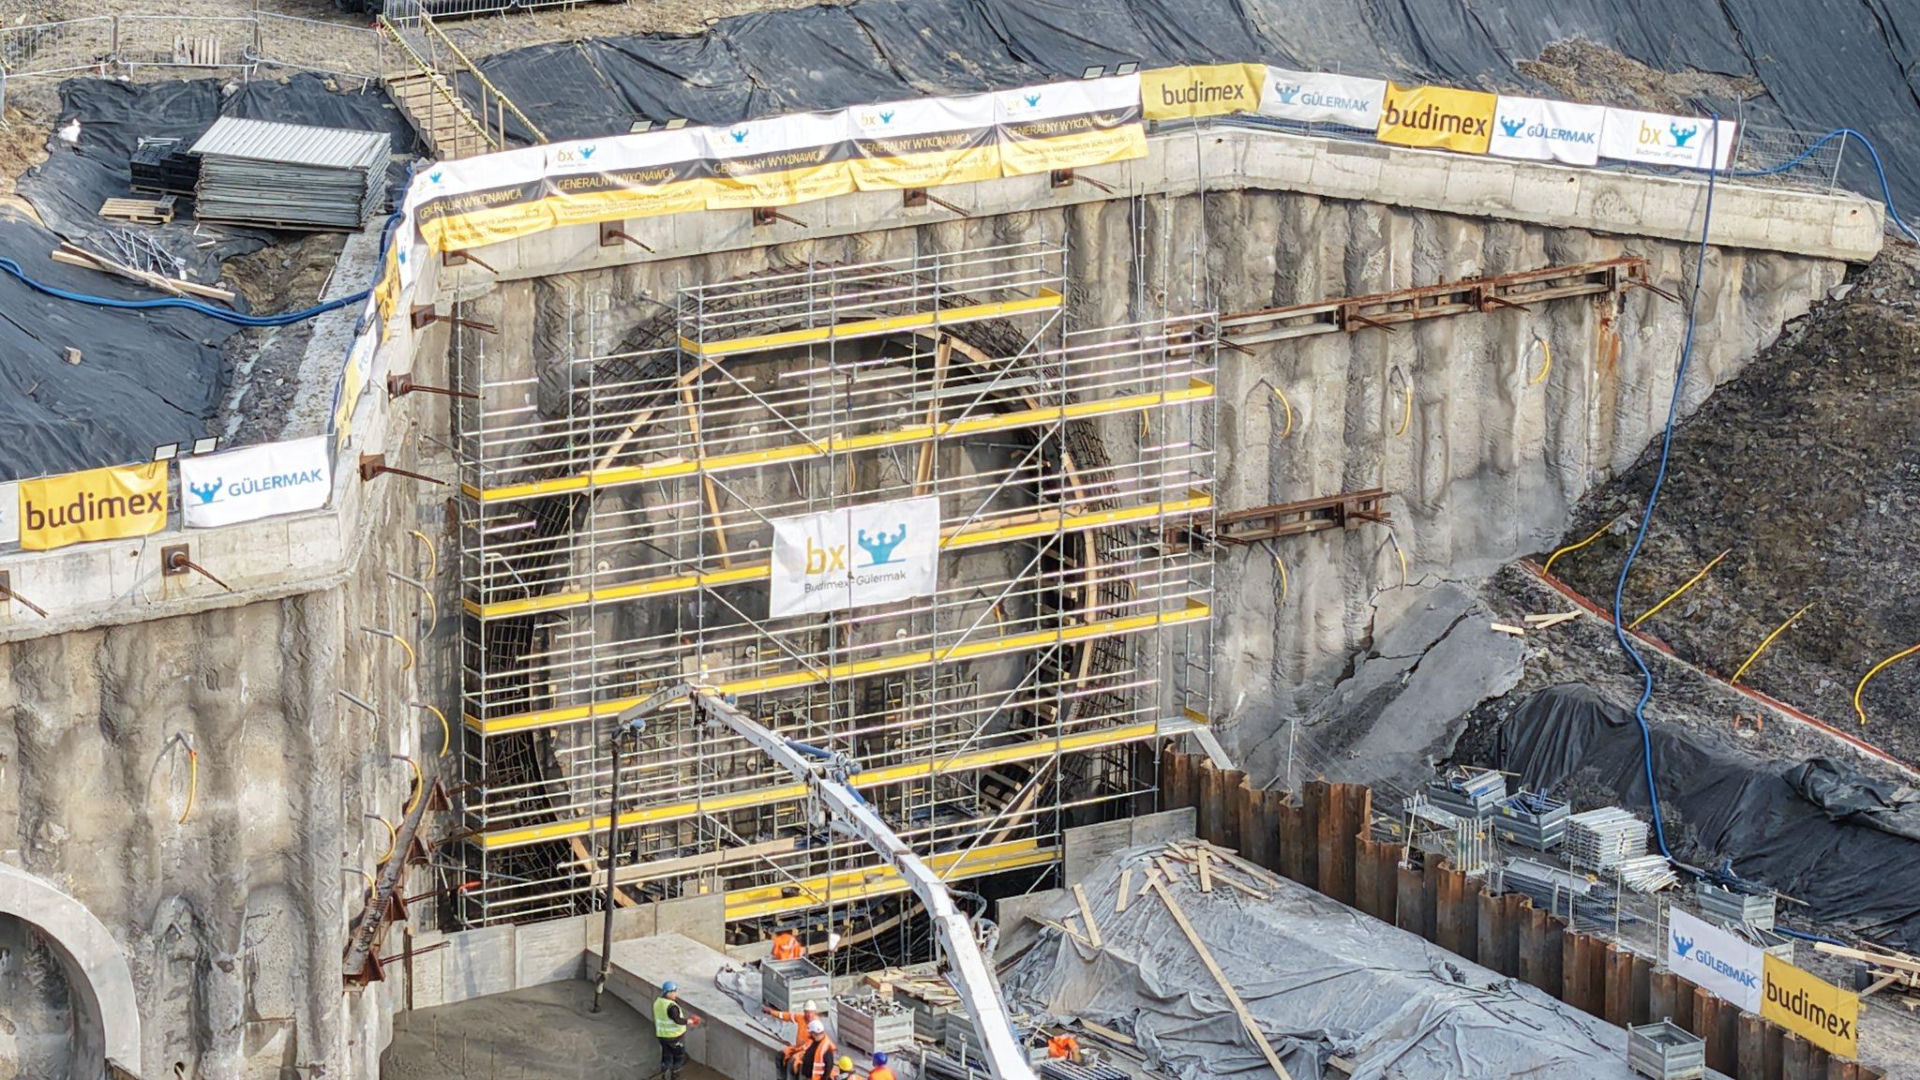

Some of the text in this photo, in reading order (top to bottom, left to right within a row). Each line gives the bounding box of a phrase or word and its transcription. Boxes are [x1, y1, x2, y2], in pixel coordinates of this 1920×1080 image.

[1162, 80, 1245, 106] budimex
[1300, 91, 1370, 113] GÜLERMAK
[1384, 99, 1488, 137] budimex
[1639, 120, 1662, 145] bx
[913, 133, 972, 149] WYKONAWCA
[1527, 123, 1595, 144] GÜLERMAK
[228, 468, 324, 497] GÜLERMAK
[26, 489, 163, 531] budimex
[805, 536, 846, 575] bx
[1695, 950, 1757, 989] GÜLERMAK
[1767, 972, 1851, 1039] budimex
